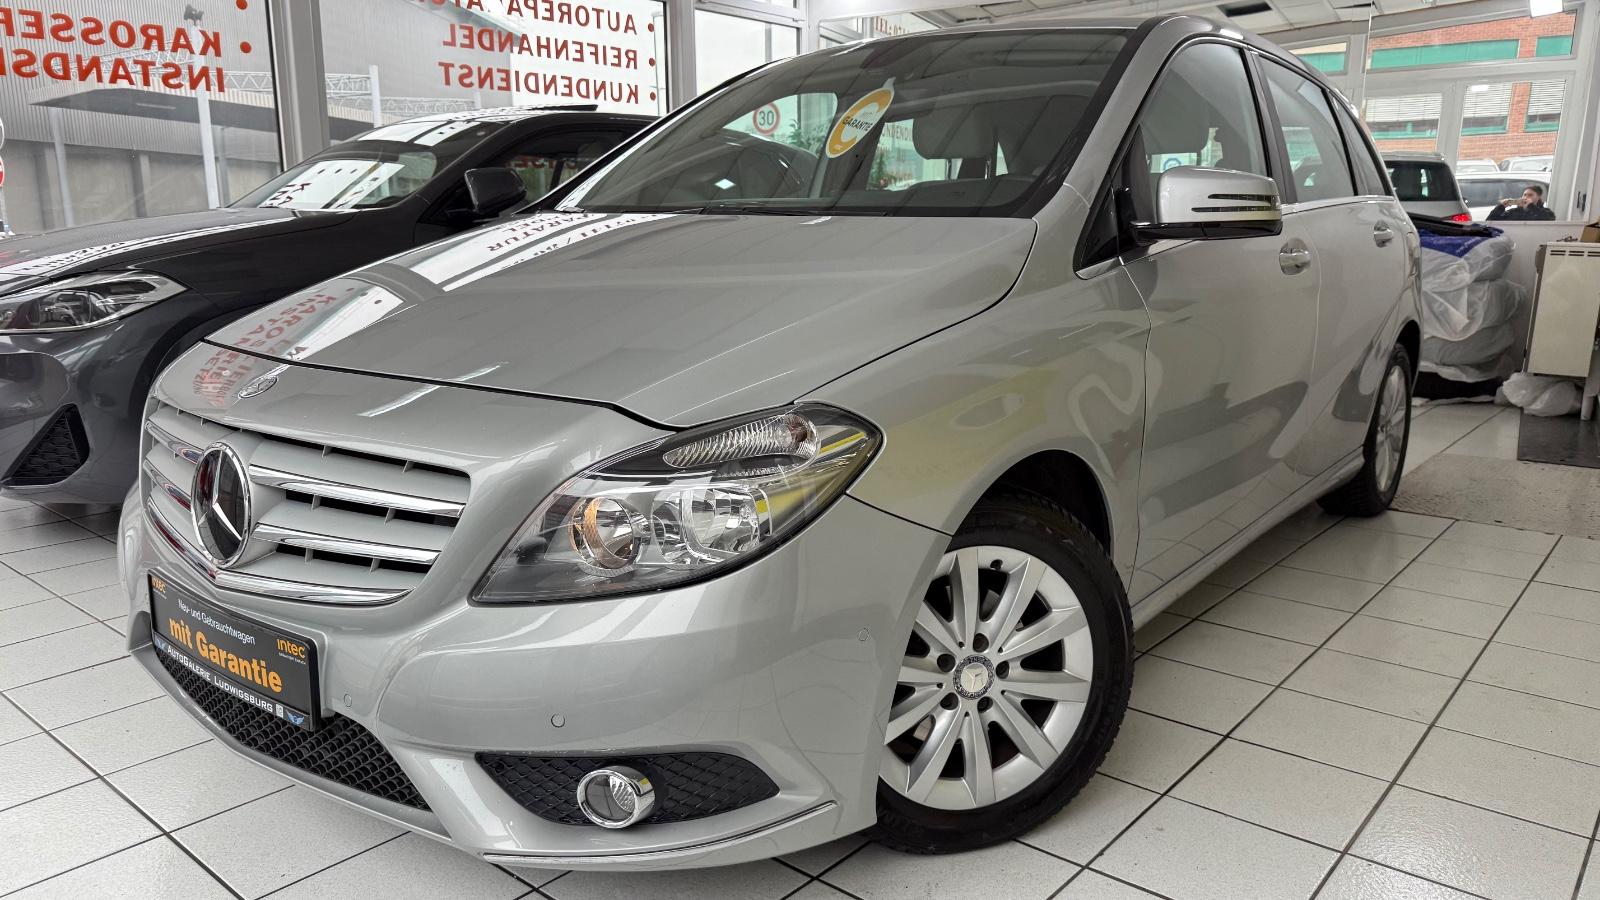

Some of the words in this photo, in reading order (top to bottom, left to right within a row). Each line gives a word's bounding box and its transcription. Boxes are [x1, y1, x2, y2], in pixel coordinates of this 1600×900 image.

[758, 110, 775, 126] 30
[190, 608, 201, 621] und
[169, 618, 193, 650] mit
[195, 631, 282, 693] Garantie
